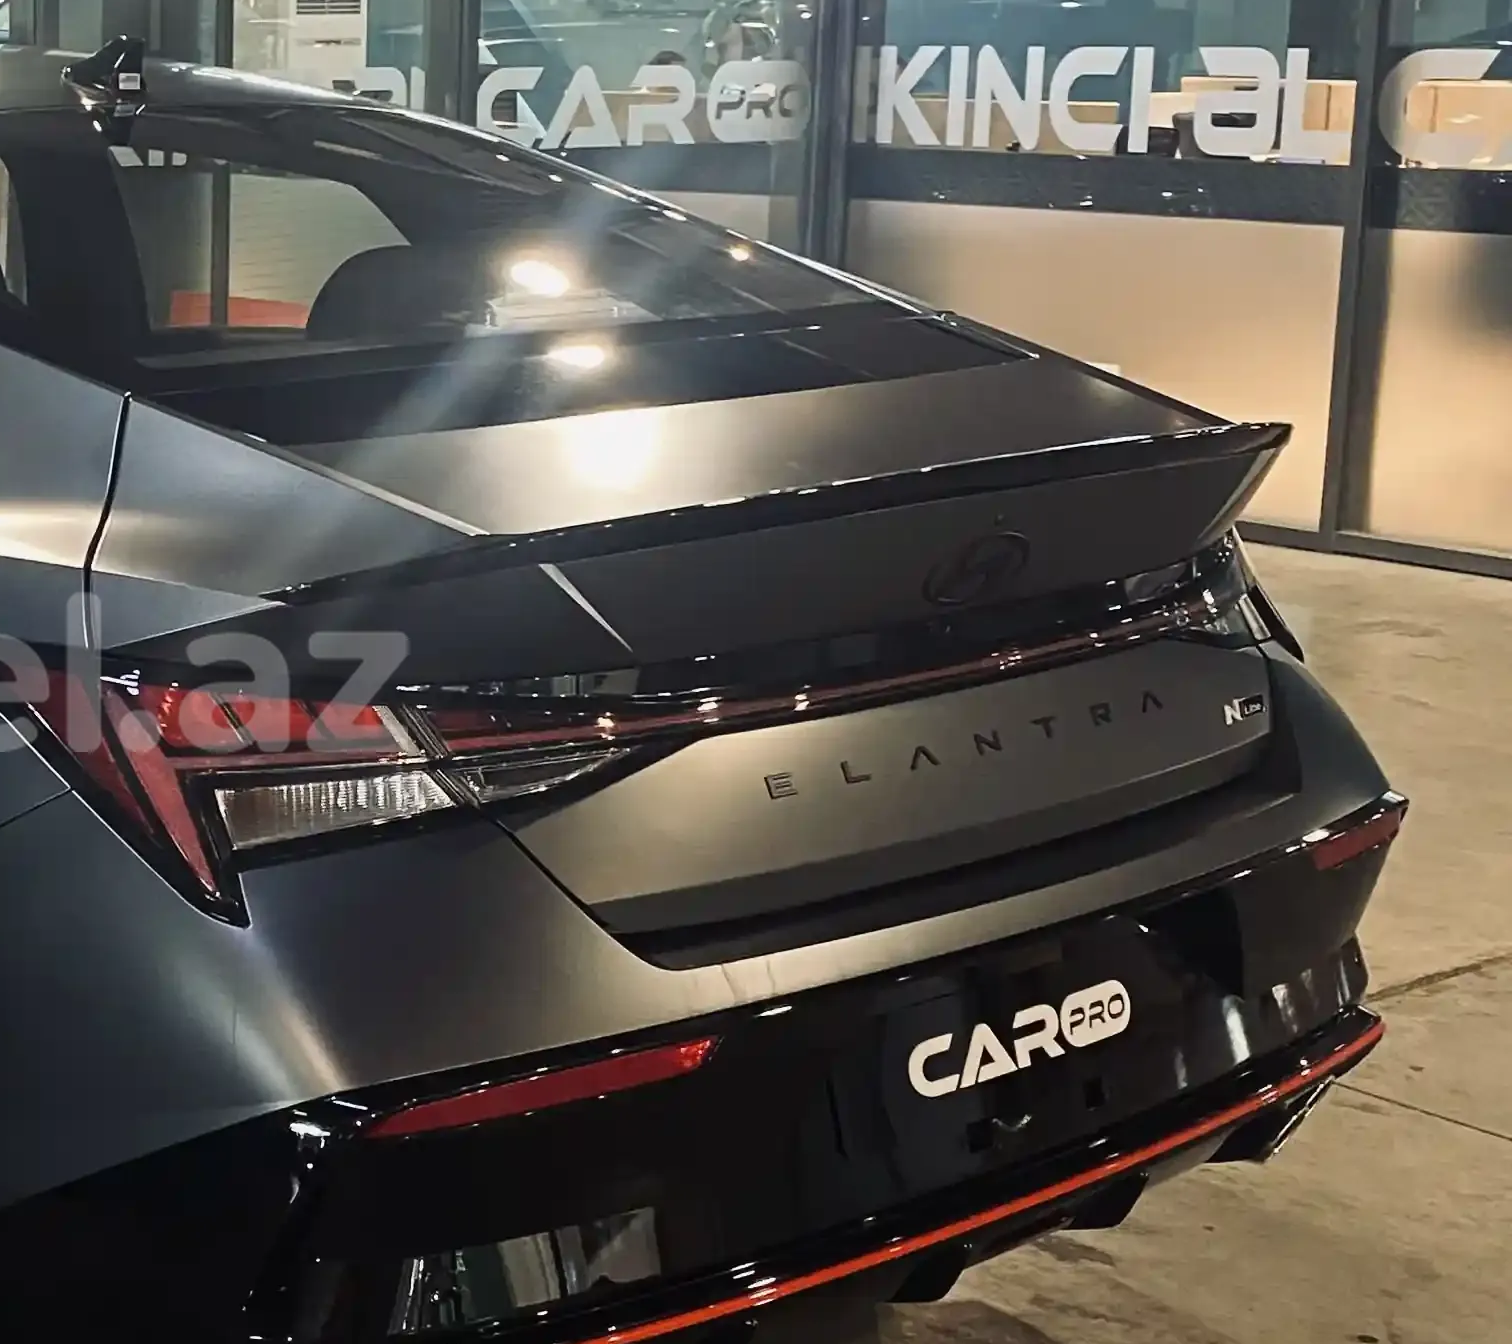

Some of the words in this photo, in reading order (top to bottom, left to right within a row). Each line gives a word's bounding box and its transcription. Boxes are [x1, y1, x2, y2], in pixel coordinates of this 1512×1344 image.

[476, 64, 695, 150] CAR
[715, 83, 808, 120] PRO
[763, 690, 1164, 801] ELANTRA
[908, 1004, 1066, 1098] CAR
[1069, 993, 1125, 1035] PRO
